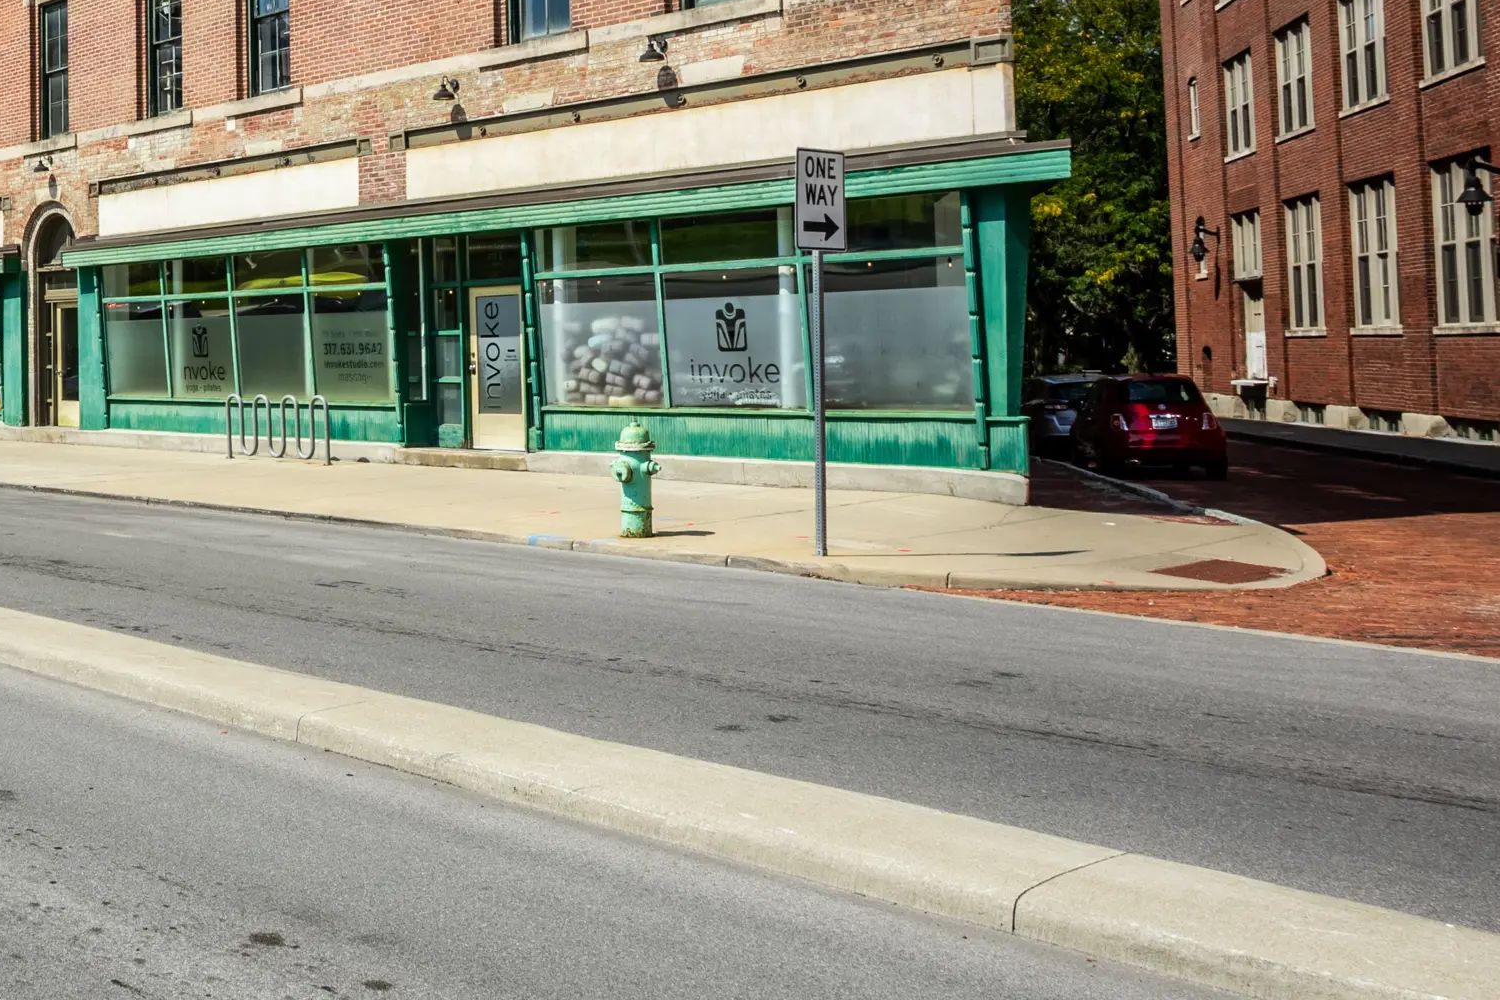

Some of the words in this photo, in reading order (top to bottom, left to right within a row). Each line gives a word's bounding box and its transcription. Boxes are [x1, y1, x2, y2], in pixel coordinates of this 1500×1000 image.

[805, 156, 836, 179] ONE
[805, 183, 838, 207] WAY
[323, 342, 384, 356] 317.631.9642
[480, 301, 501, 409] invoke
[183, 361, 226, 381] nvoke
[690, 356, 780, 384] invoke
